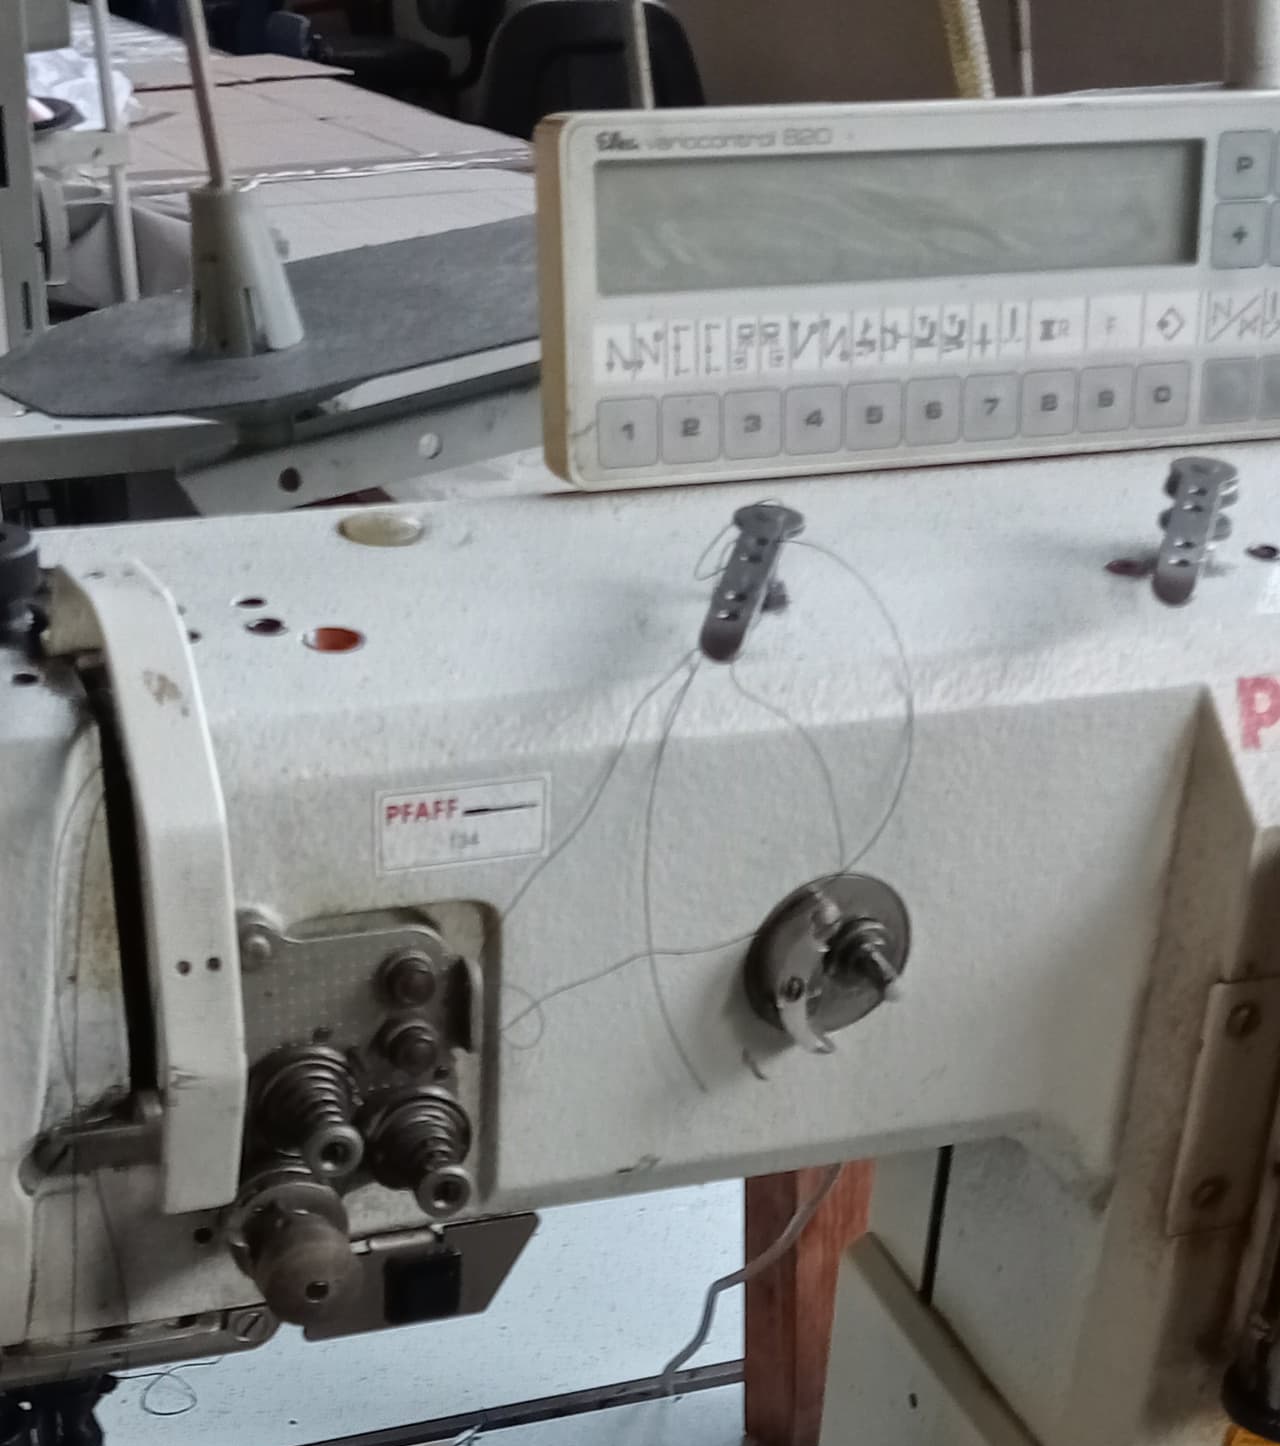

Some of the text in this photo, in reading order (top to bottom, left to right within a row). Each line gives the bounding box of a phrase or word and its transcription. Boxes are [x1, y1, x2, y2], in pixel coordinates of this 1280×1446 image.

[783, 127, 833, 146] 820
[1236, 155, 1254, 174] P
[622, 421, 635, 440] 1
[681, 417, 700, 437] 2
[743, 414, 762, 433] 3
[804, 409, 824, 427] 4
[925, 401, 943, 420] 6
[984, 397, 1000, 416] 7
[384, 797, 459, 826] PFAFF
